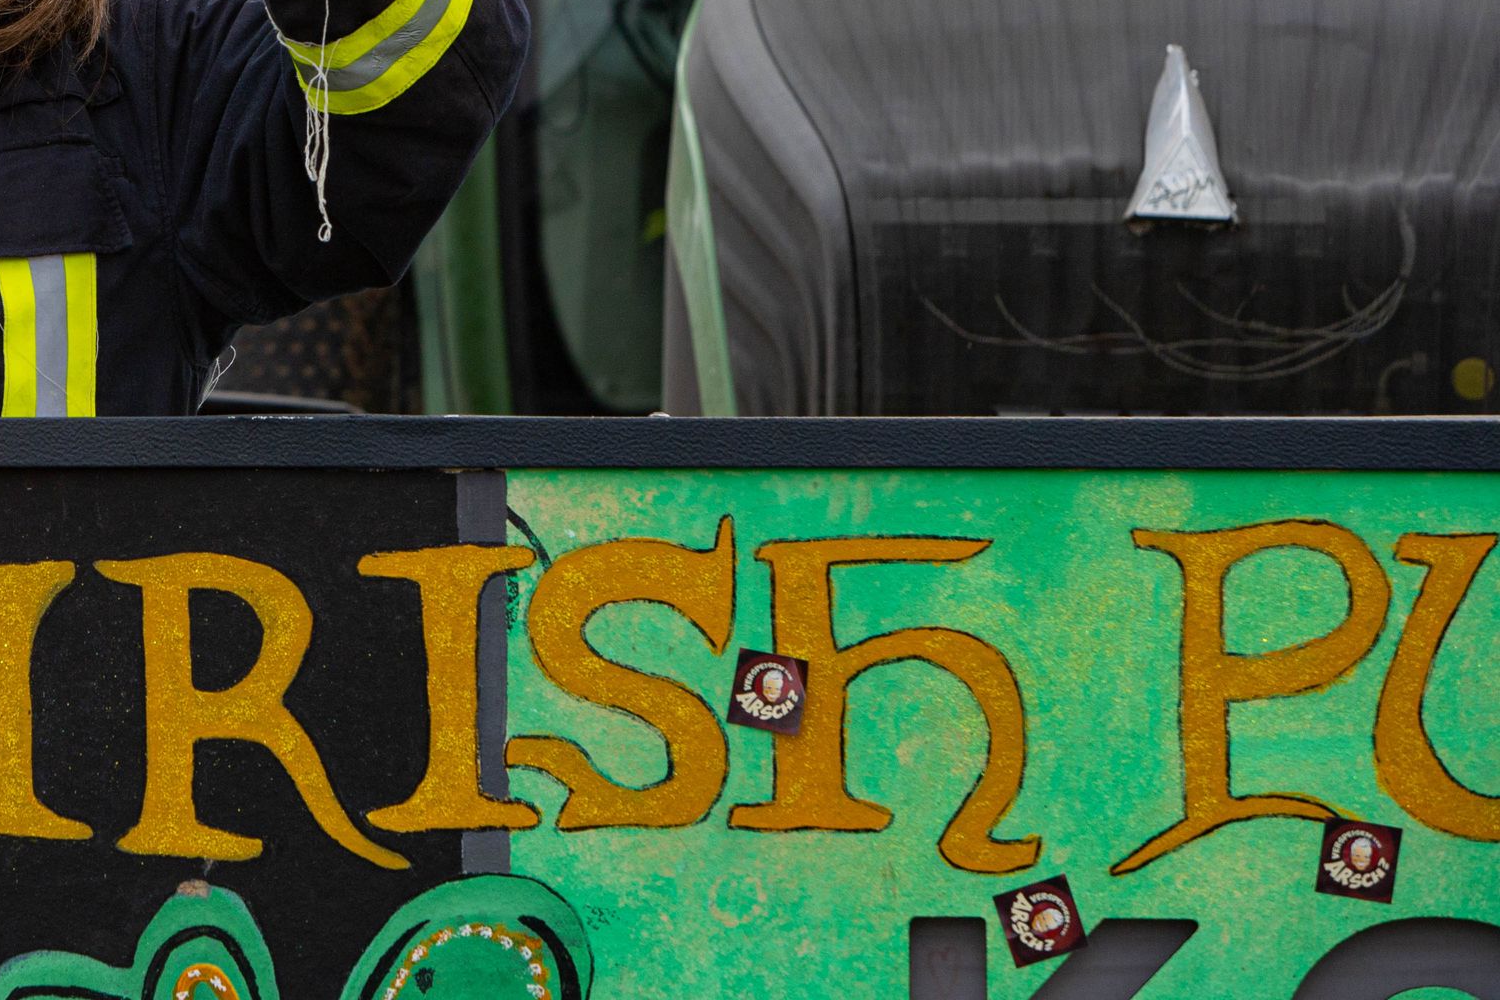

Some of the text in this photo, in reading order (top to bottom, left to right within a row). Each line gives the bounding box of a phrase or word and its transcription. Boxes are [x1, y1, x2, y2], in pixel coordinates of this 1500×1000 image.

[735, 689, 799, 721] ARSCH?
[1323, 857, 1390, 889] ARSCH?
[1010, 892, 1055, 952] ARSCH?
